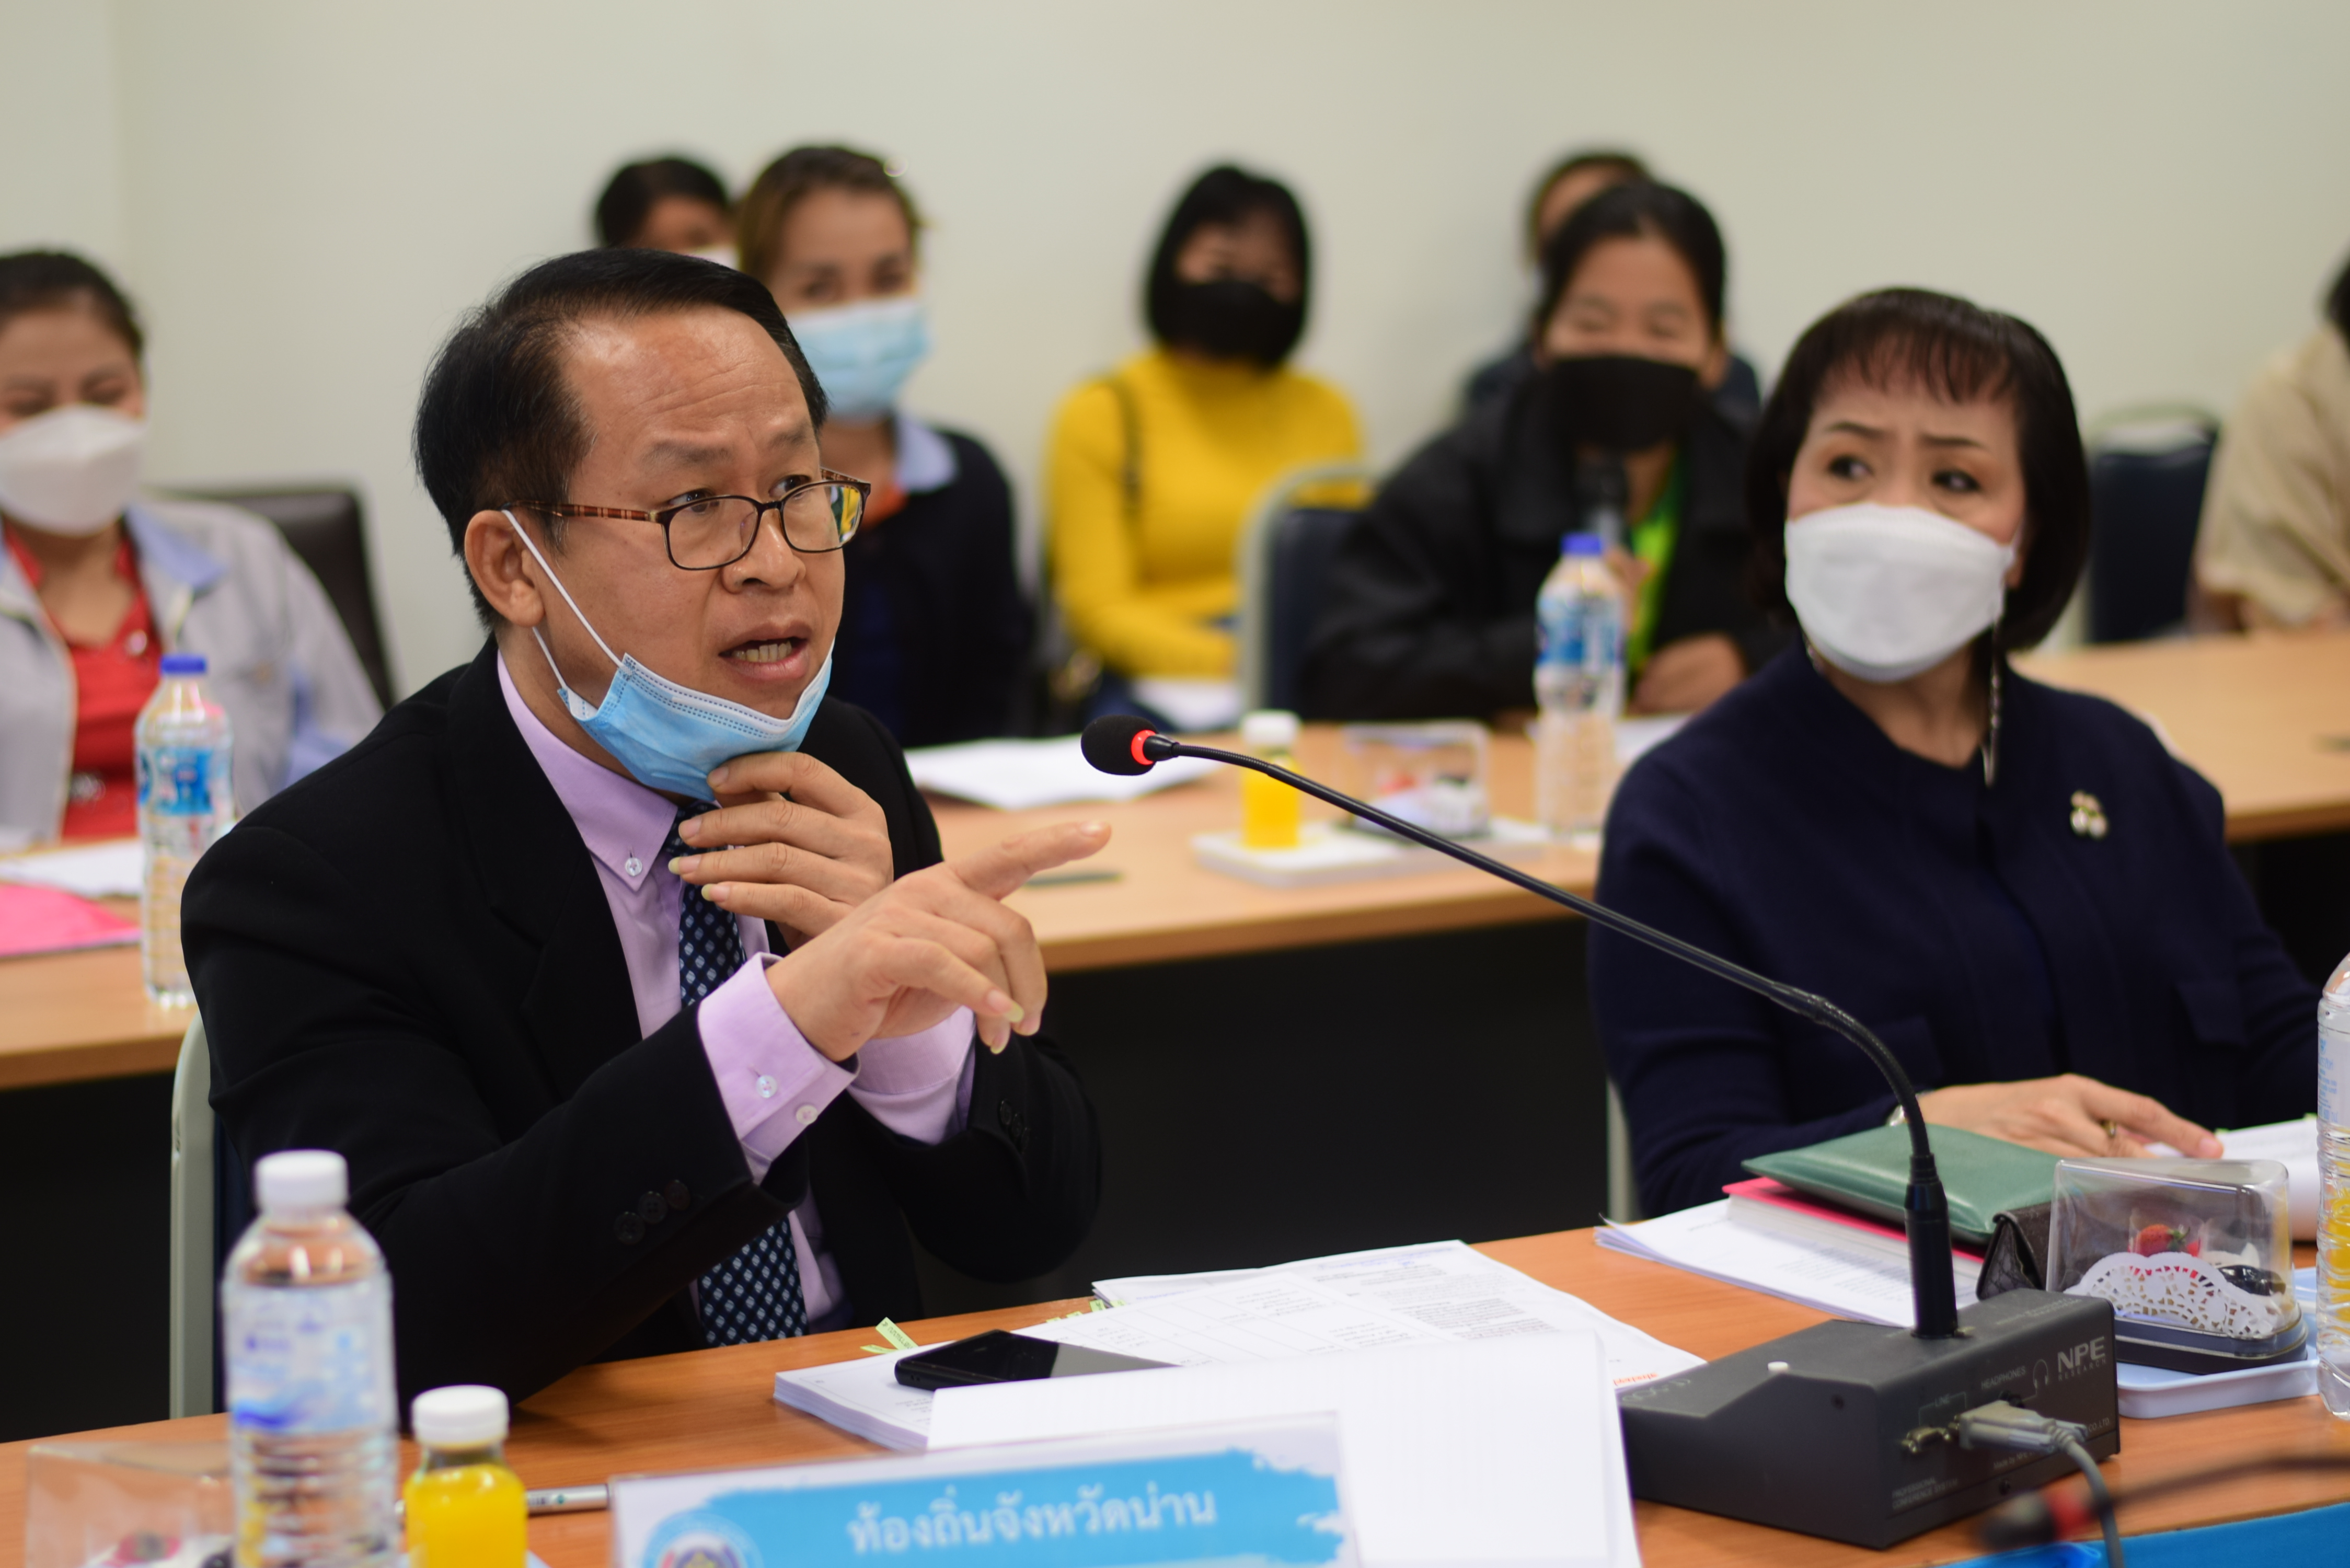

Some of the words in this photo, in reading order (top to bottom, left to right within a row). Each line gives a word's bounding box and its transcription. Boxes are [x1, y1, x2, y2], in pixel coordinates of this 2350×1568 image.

[2057, 1336, 2105, 1373] NPE
[1980, 1365, 2027, 1390] HEADPHONES
[2058, 1358, 2107, 1381] RESEARCH
[1935, 1392, 1950, 1408] LINE
[1892, 1476, 1937, 1499] PROFESSIONAL
[1892, 1487, 1933, 1510] CONFERENCE
[1934, 1478, 1959, 1494] SYSTEM
[846, 1481, 1217, 1554] ท้องถิ่นจังหวัดน่าน
